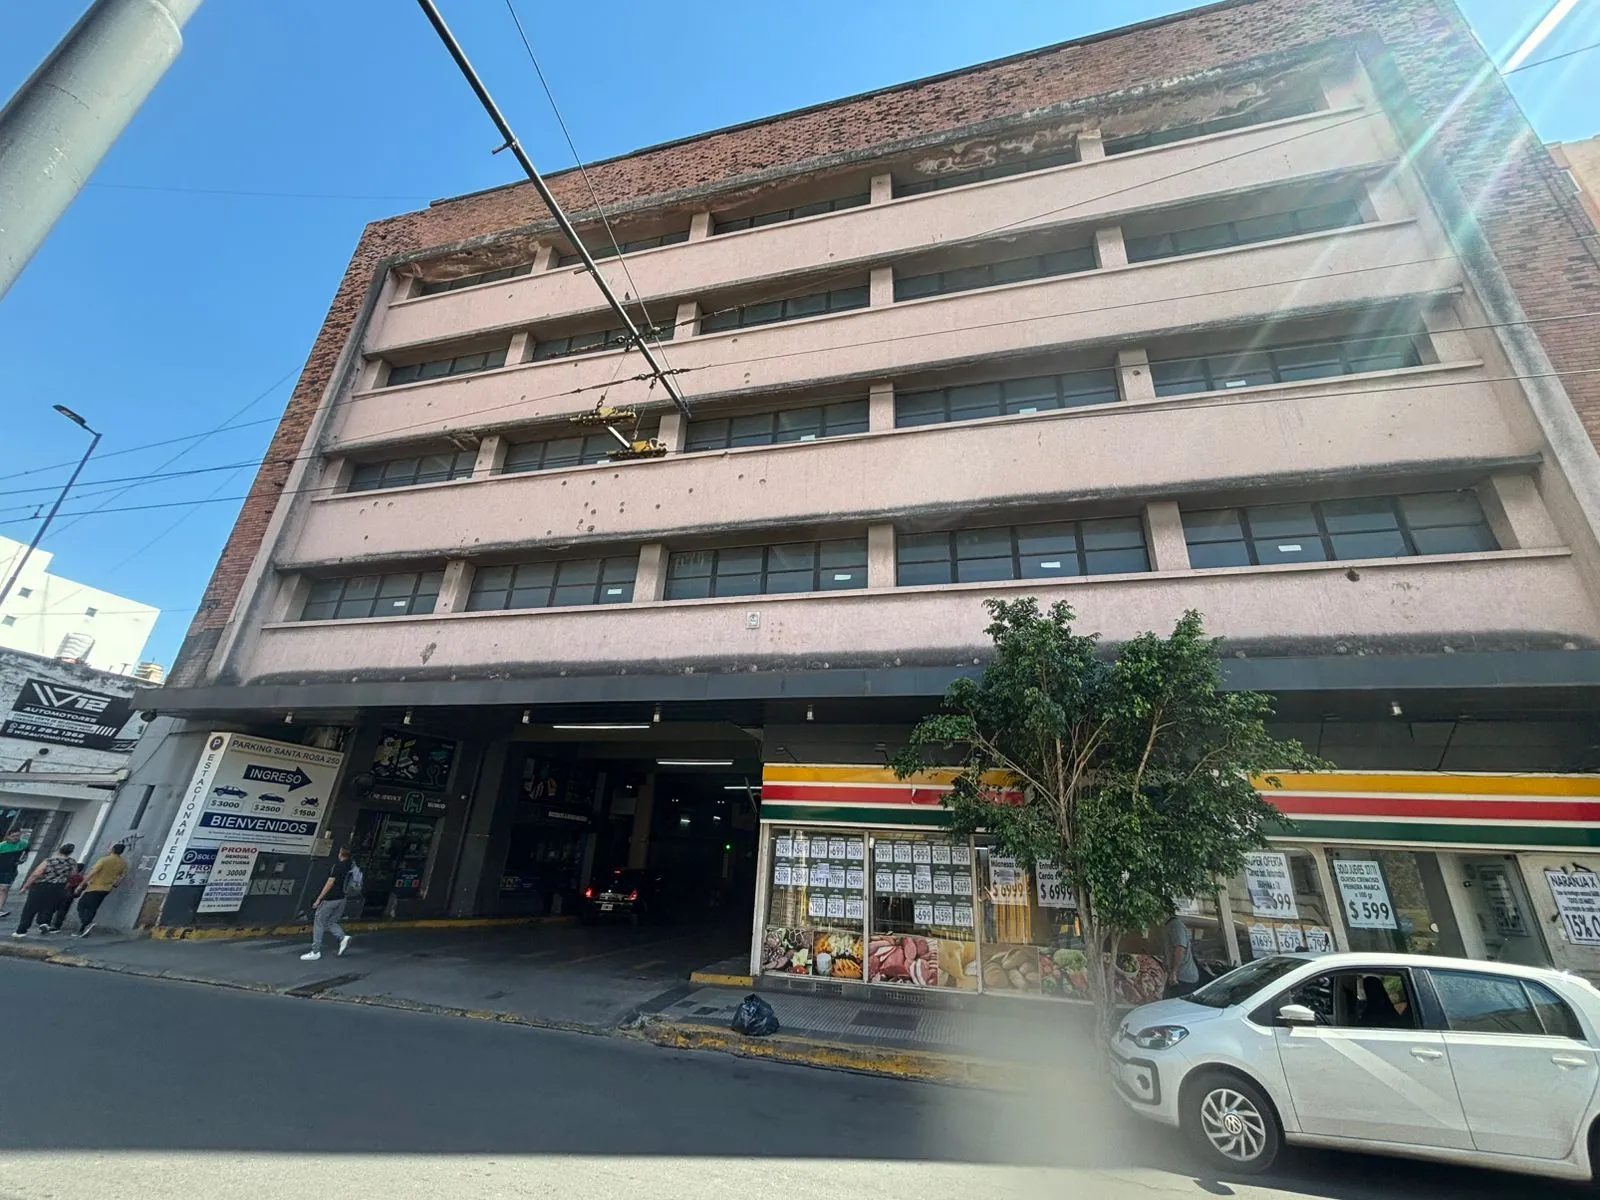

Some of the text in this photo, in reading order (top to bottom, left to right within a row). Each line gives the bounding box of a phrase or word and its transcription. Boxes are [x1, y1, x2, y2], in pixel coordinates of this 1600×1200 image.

[23, 706, 97, 723] AUTOMOTORES
[232, 740, 340, 765] PARKING SANTA ROSA 250
[250, 768, 302, 784] INGRESO
[158, 754, 215, 881] ESTACIONAMIENTO
[210, 815, 308, 833] BIENVENIDOS
[221, 846, 258, 854] PROMO
[1040, 882, 1046, 900] $
[1550, 875, 1598, 889] NARANJA X
[1349, 900, 1390, 920] $ 599
